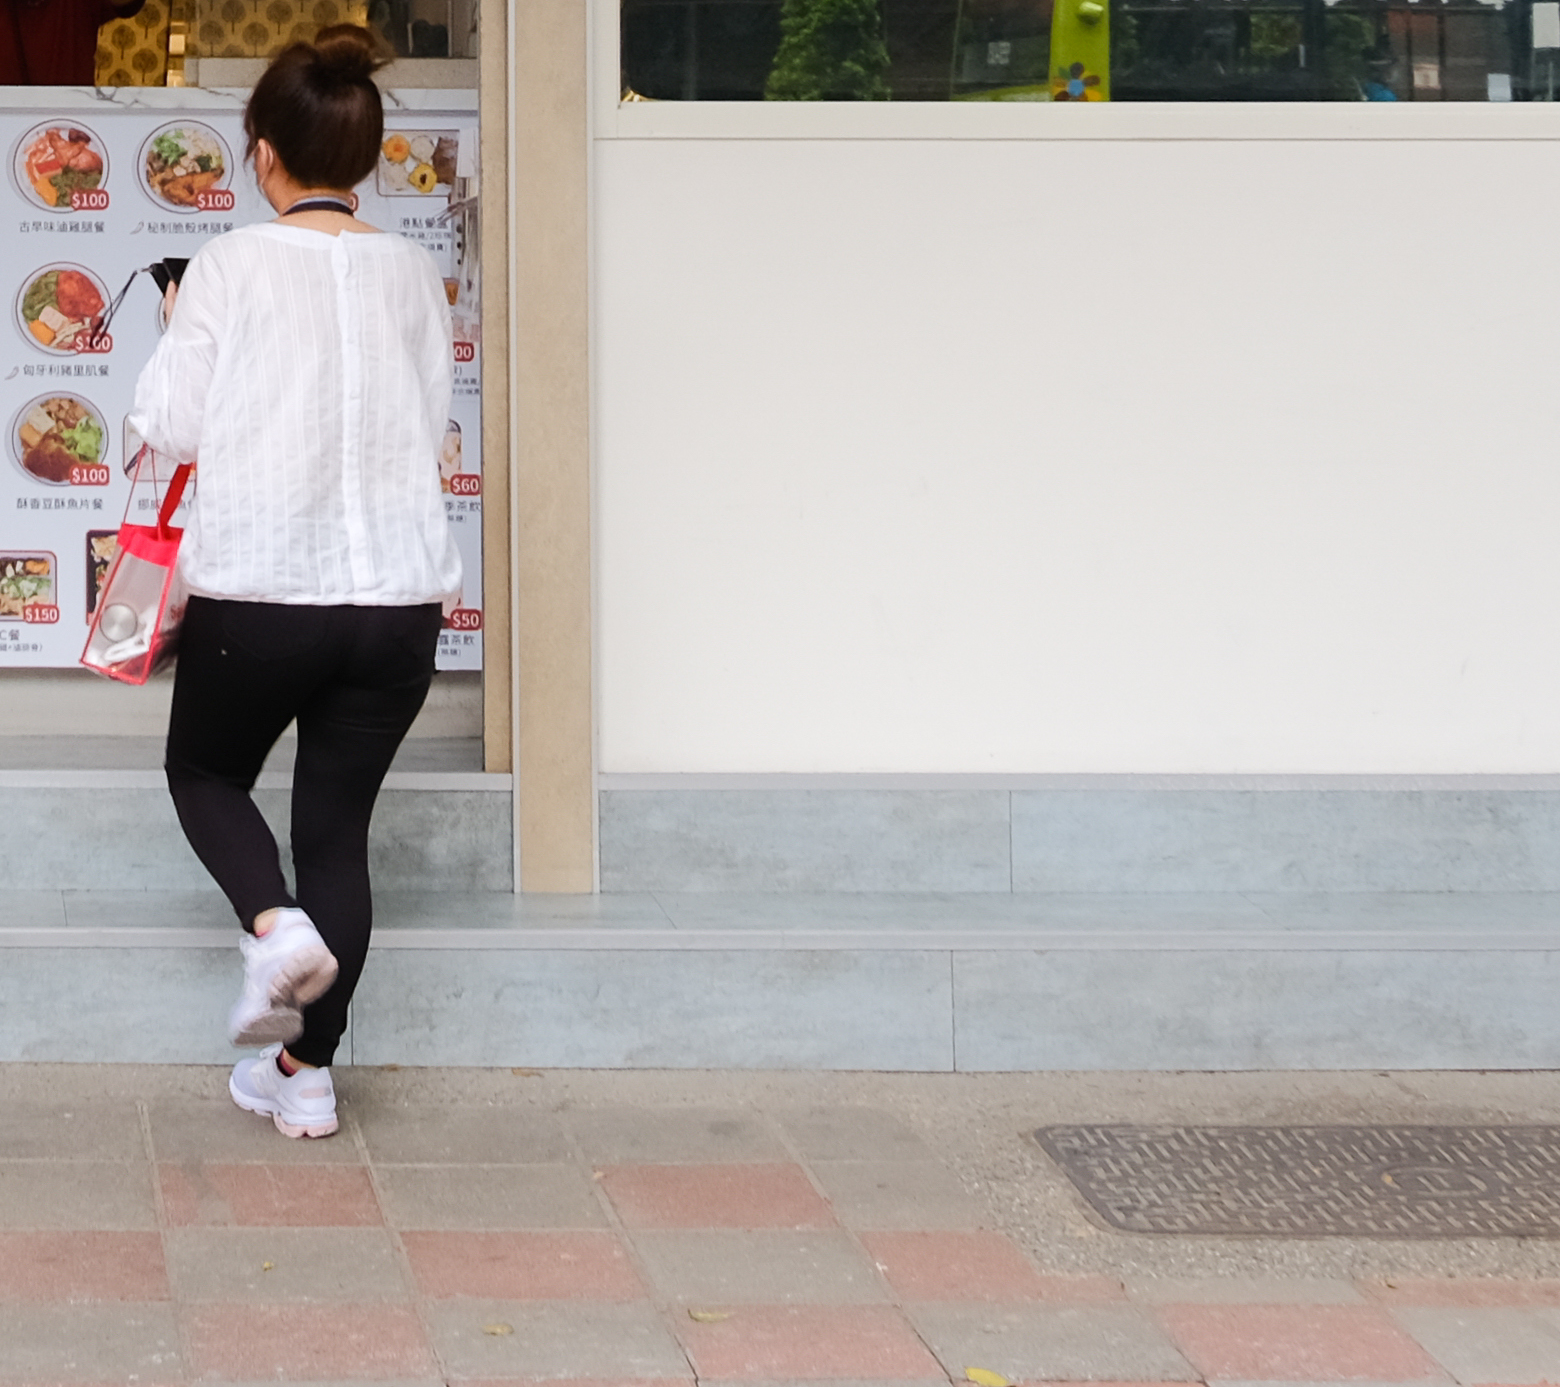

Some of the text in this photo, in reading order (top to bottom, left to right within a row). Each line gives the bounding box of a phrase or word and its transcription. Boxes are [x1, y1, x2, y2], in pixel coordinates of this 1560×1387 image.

[72, 193, 108, 208] $100
[197, 193, 233, 208] $100
[74, 335, 111, 351] $100
[72, 467, 108, 483] $100
[452, 477, 480, 493] $60
[24, 607, 59, 622] $150
[452, 611, 480, 627] $50
